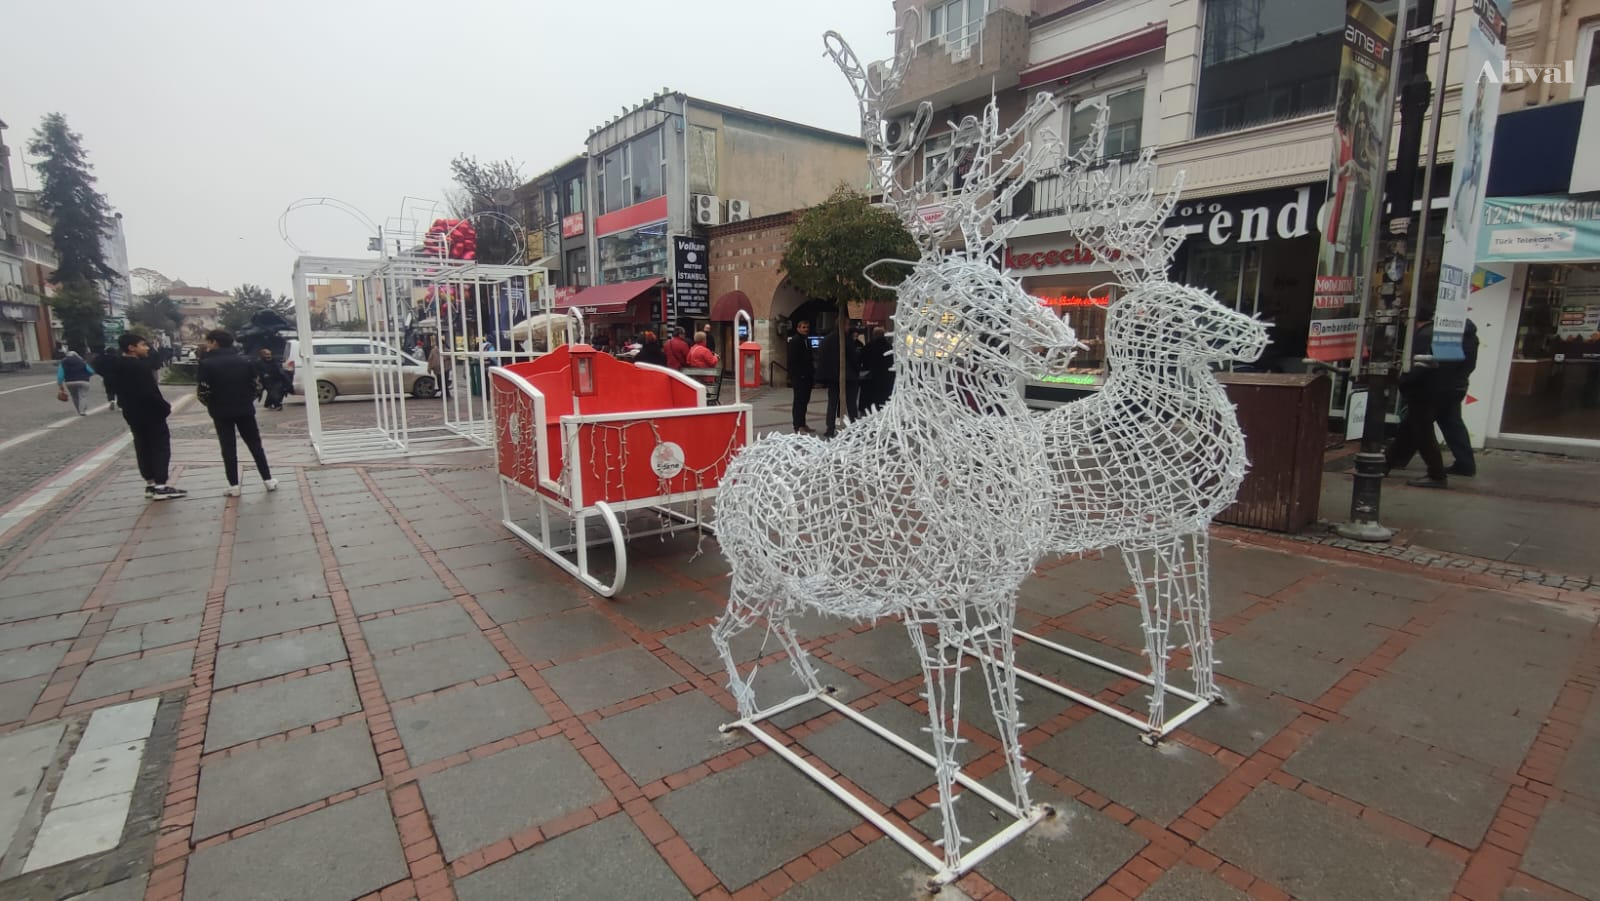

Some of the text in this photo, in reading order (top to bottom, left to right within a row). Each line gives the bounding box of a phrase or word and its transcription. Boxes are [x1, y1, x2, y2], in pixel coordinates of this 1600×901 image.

[1485, 206, 1502, 225] 12
[1505, 205, 1527, 224] AY
[678, 241, 706, 252] Volkan
